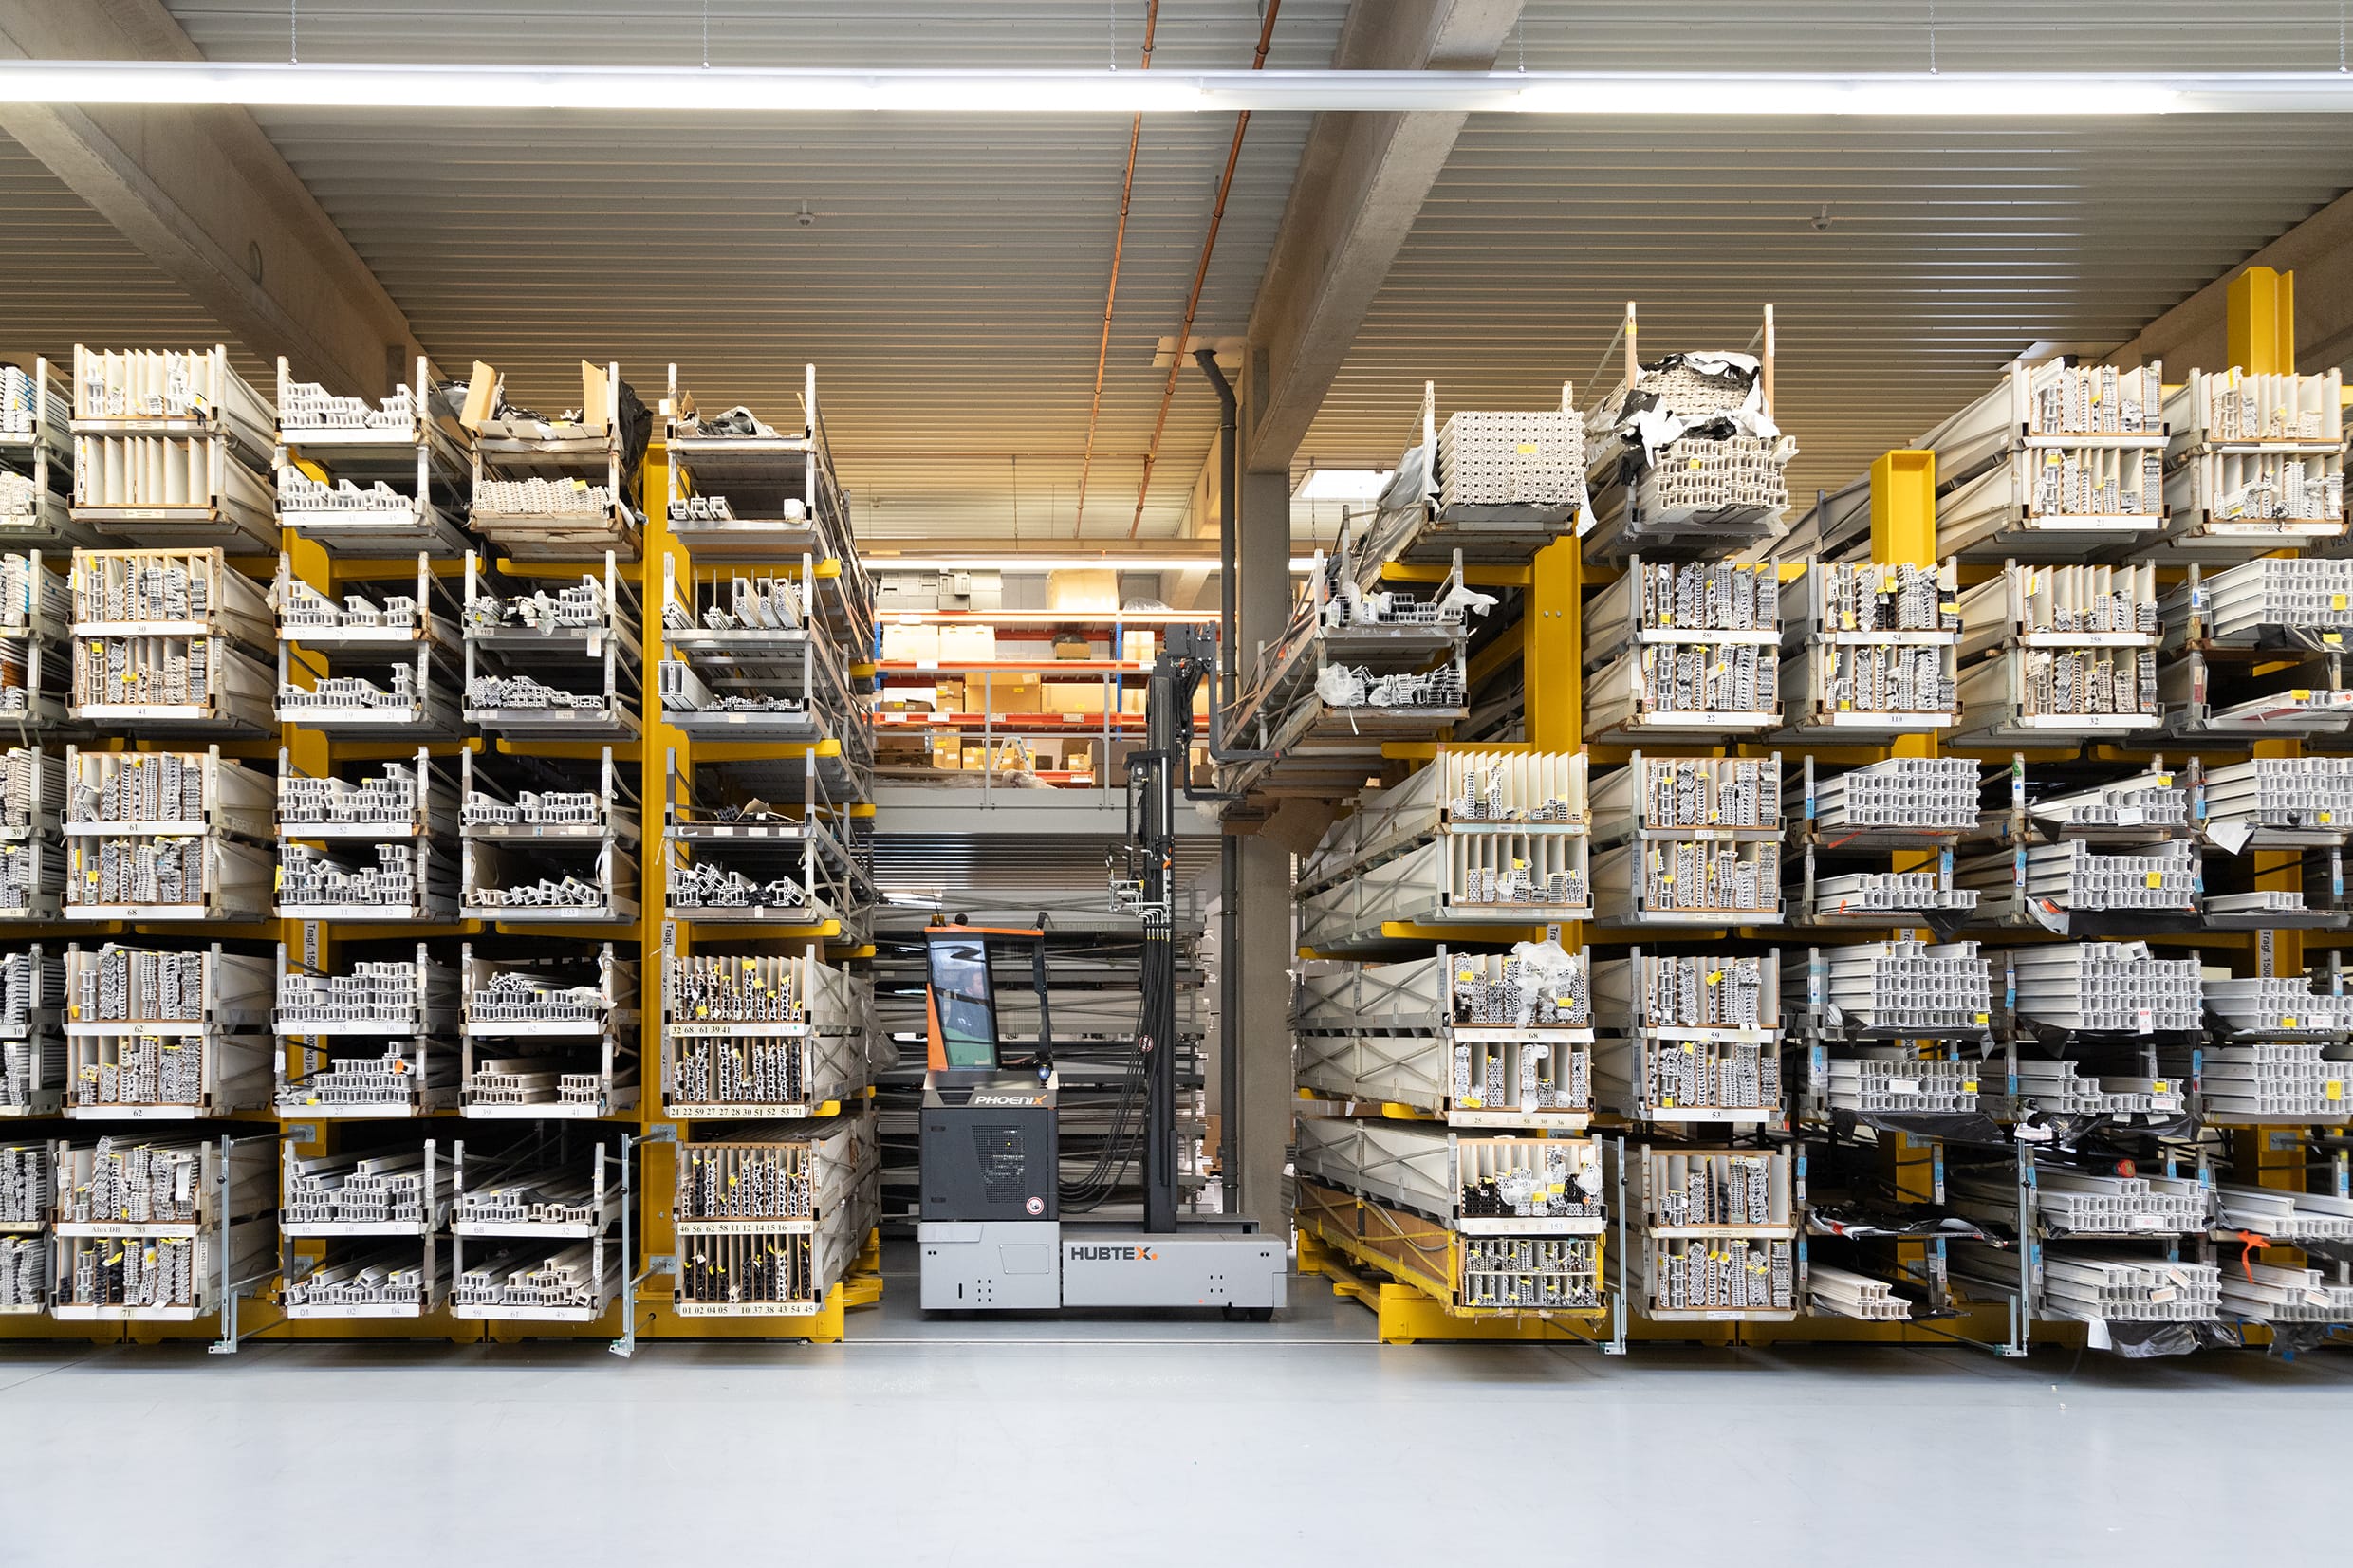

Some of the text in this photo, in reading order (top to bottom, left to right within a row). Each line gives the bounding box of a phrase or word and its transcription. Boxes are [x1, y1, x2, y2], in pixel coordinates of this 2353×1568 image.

[339, 825, 347, 834] 52
[306, 924, 316, 949] Tragf.
[2261, 932, 2271, 978] Tragf. 1500
[305, 1049, 315, 1060] kg
[975, 1094, 1047, 1105] PHOENIX
[1070, 1246, 1151, 1261] HUBTEX
